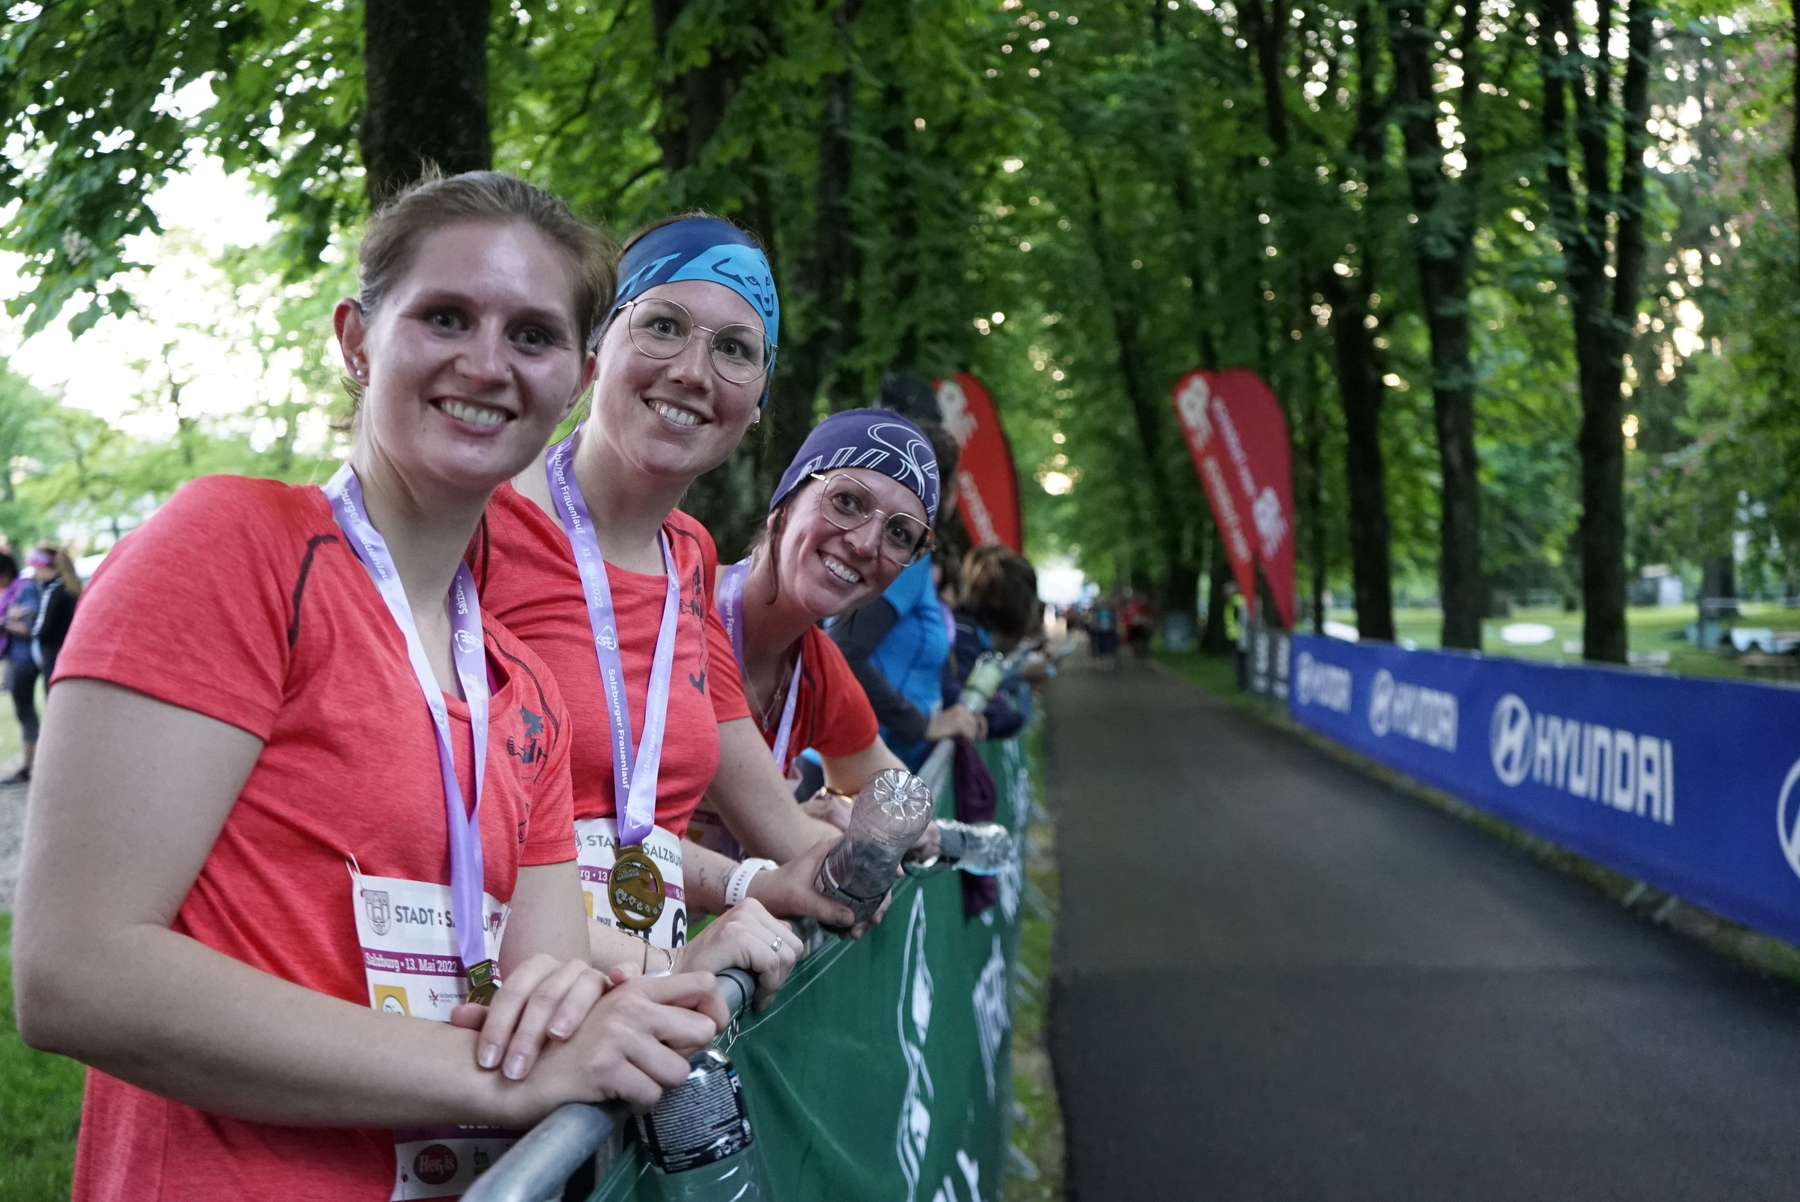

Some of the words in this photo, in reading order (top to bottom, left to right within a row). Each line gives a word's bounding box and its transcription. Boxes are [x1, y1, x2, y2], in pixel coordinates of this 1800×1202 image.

[561, 485, 586, 534] Frauenlauf
[591, 582, 603, 608] 2022
[608, 668, 623, 728] Salzburger
[617, 729, 630, 790] Frauenlauf
[642, 733, 657, 790] Salzburger
[651, 679, 663, 733] Frauenlauf
[1533, 711, 1675, 826] HYUNDAI
[395, 905, 434, 926] STADT
[365, 952, 399, 973] Salzburg
[404, 957, 417, 971] 13.
[419, 958, 435, 973] Mai
[437, 962, 458, 973] 2022
